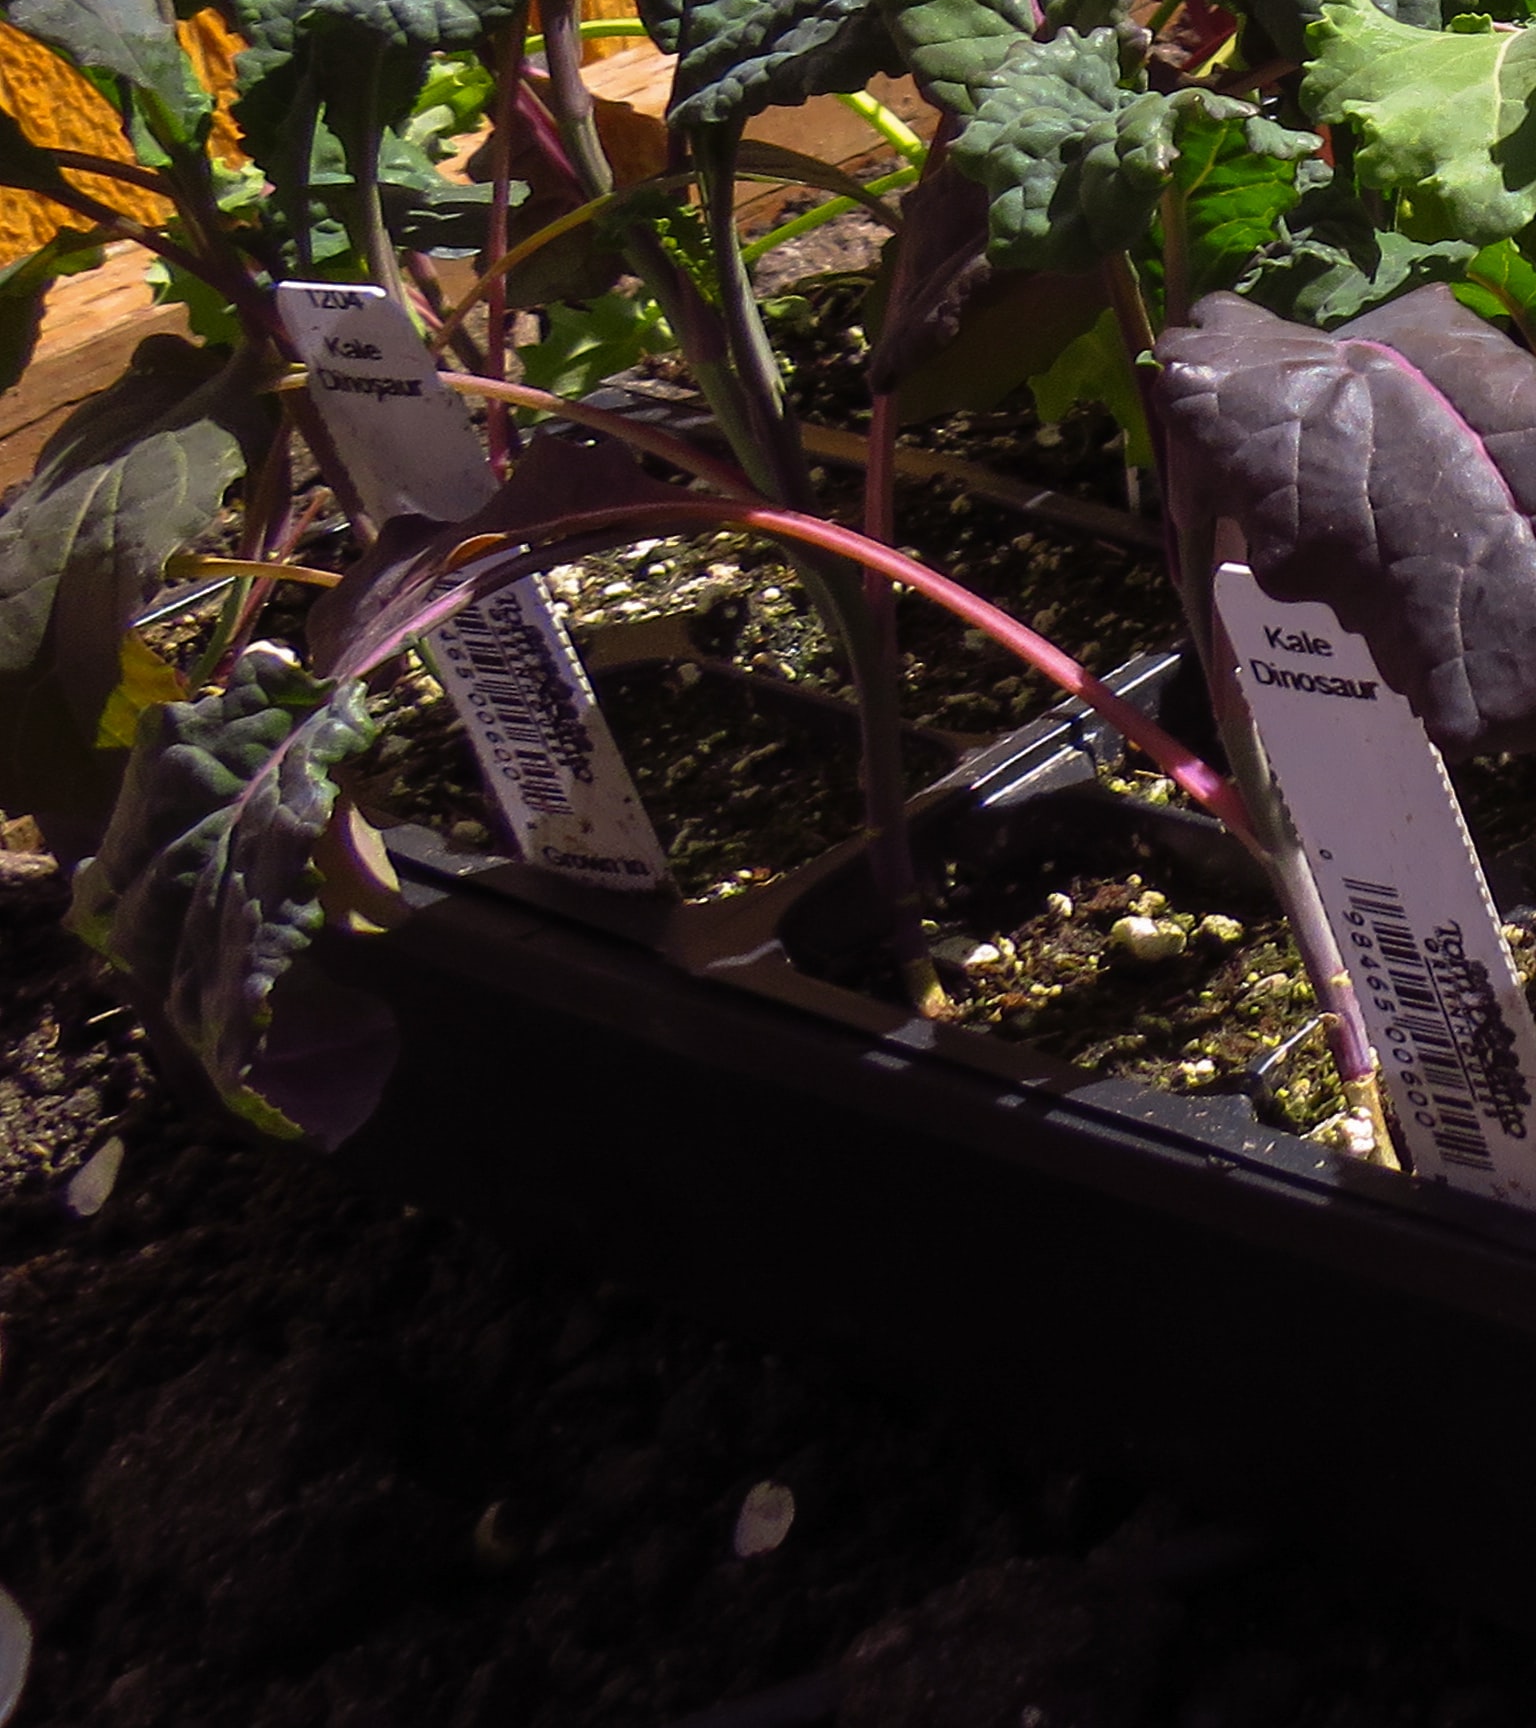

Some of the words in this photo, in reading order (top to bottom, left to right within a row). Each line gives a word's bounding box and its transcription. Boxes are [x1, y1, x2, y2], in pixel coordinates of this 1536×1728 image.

[324, 336, 383, 361] Kale
[316, 366, 423, 397] Dinosaur
[1263, 624, 1334, 657] Kale
[1249, 658, 1379, 701] Dinosaur
[467, 692, 520, 780] 00600
[1343, 909, 1396, 1013] 98465
[1385, 1027, 1435, 1128] 00600
